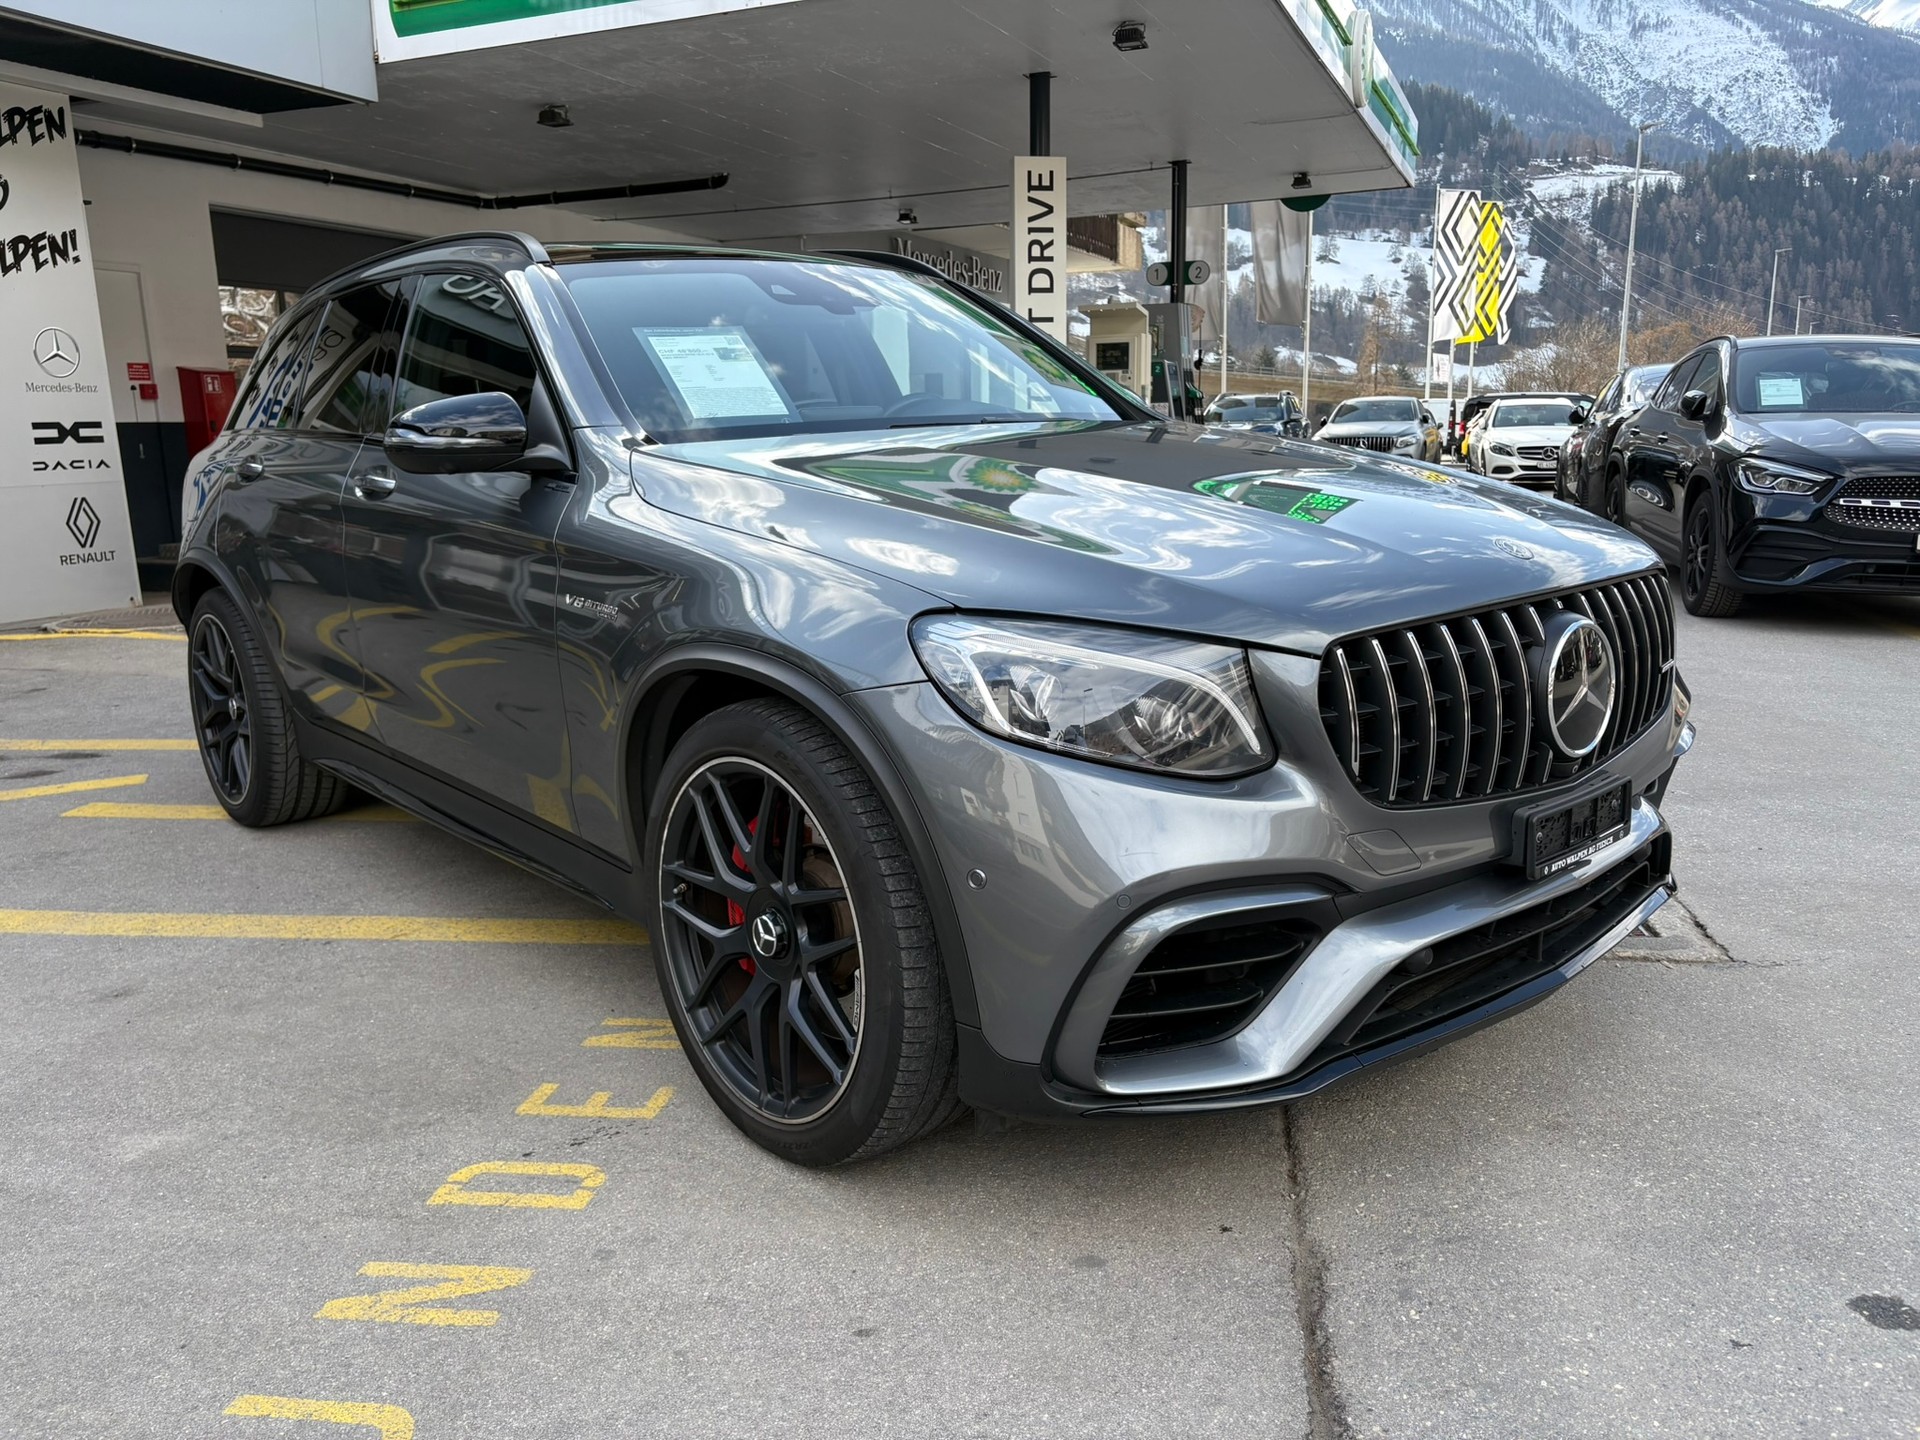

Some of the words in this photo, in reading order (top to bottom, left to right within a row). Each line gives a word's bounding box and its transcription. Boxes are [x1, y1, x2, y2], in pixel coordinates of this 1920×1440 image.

[1027, 170, 1054, 295] DRIVE
[0, 229, 81, 277] LPEN!
[1154, 268, 1159, 281] 1
[1195, 266, 1202, 279] 2
[25, 382, 99, 393] Mercedes-Benz
[32, 459, 111, 471] DACIA
[60, 550, 116, 566] RENAULT
[1551, 860, 1566, 872] AUTO
[1566, 849, 1588, 864] WALPEN
